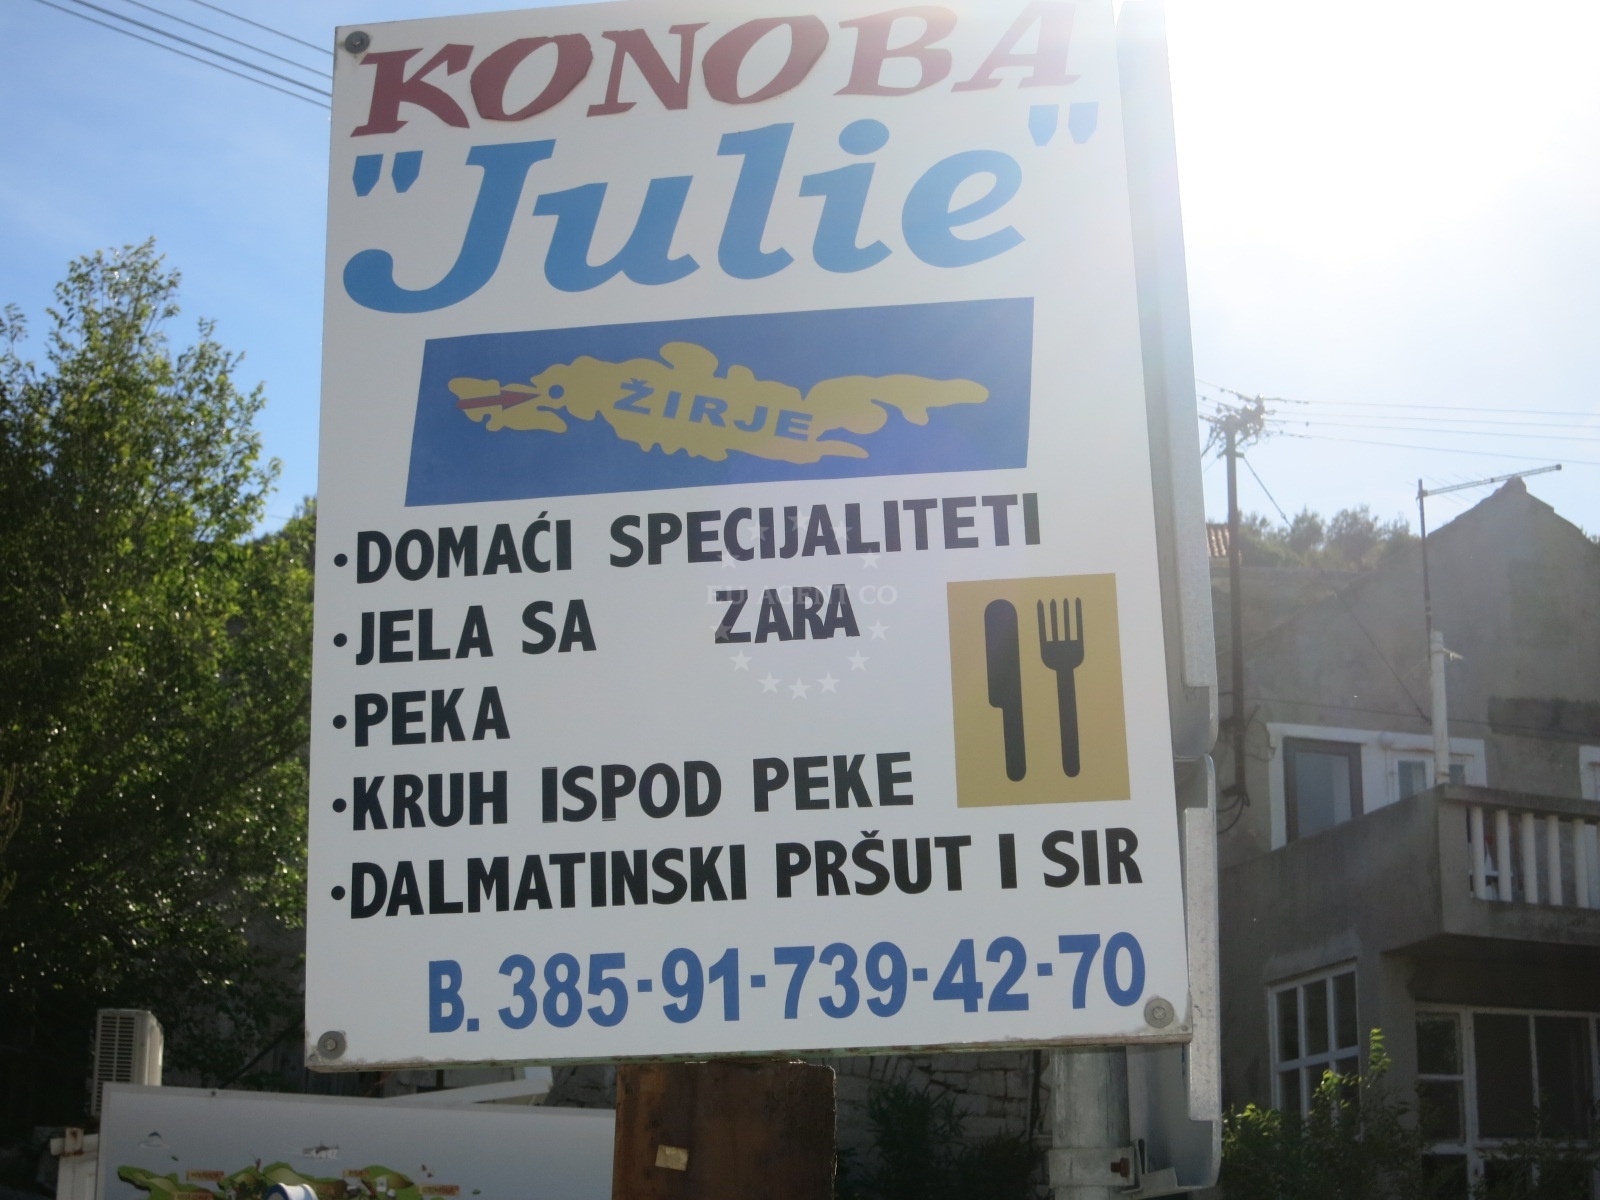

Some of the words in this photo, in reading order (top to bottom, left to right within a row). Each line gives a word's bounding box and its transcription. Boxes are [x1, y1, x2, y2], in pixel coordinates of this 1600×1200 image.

[351, 1, 1080, 137] KONOBA
[614, 378, 815, 442] ŽIRJE
[610, 493, 1041, 567] SPECIJALITETI
[522, 599, 597, 653] SA
[714, 583, 861, 644] ZARA
[541, 760, 722, 823] ISPOD
[753, 751, 915, 811] PEKE
[776, 830, 971, 898] PRŠUT
[999, 832, 1018, 891] I
[1043, 827, 1143, 887] SIR
[429, 959, 480, 1034] B.
